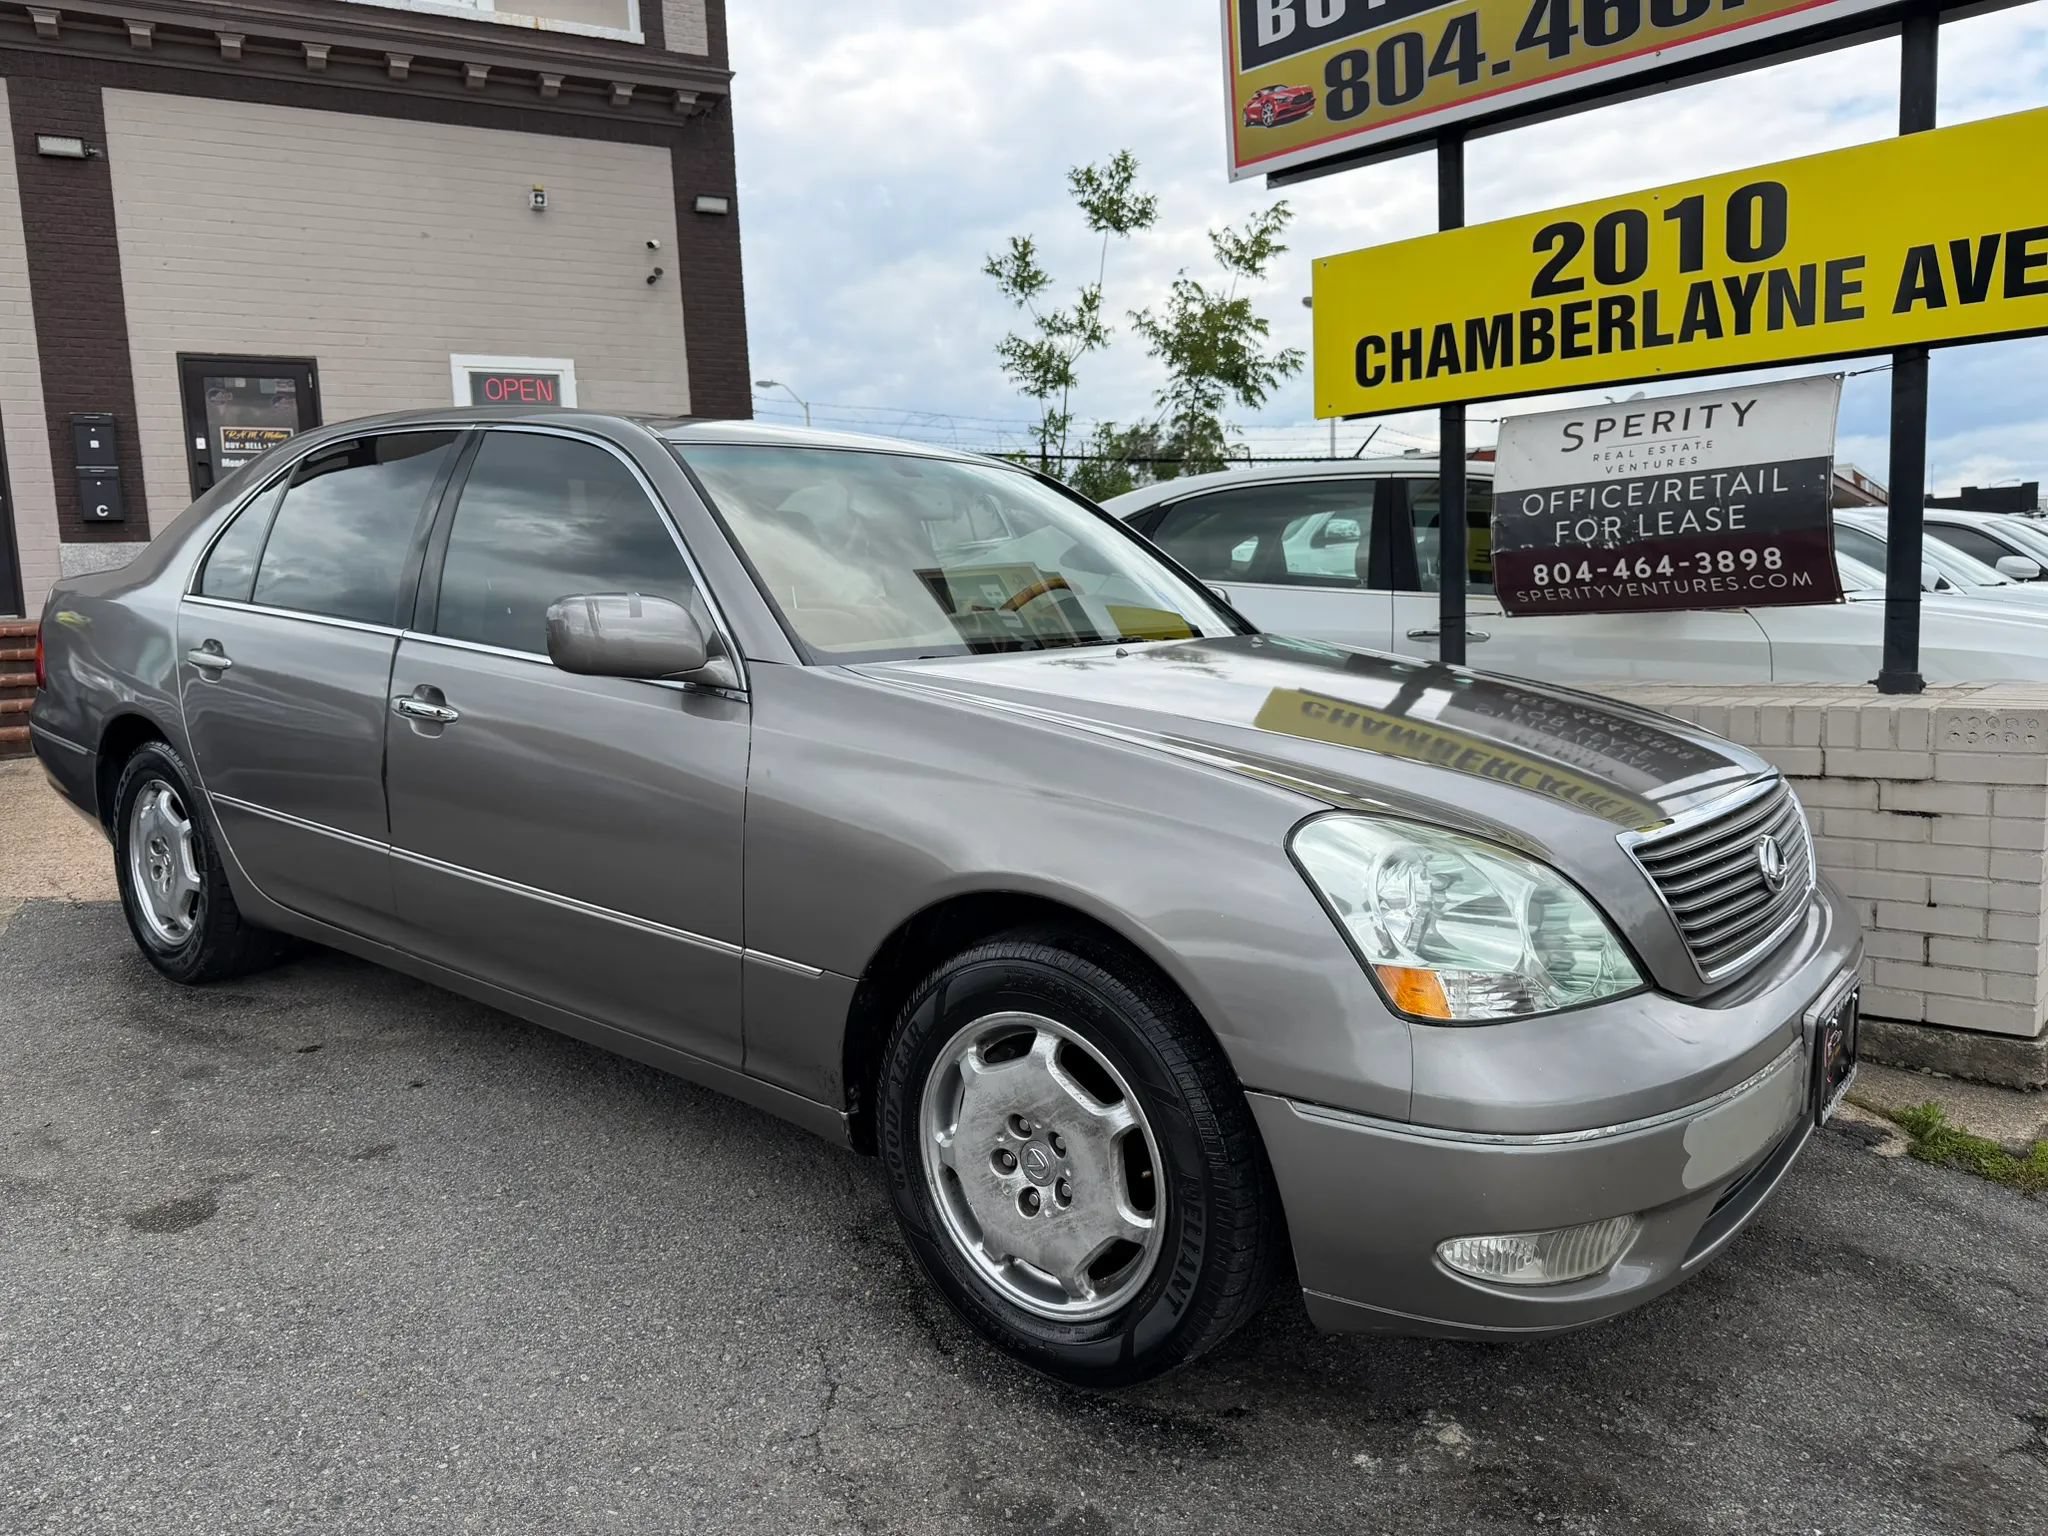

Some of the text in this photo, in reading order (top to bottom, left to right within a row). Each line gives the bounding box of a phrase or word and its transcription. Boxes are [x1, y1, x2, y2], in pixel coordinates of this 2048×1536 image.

[1531, 181, 1787, 298] 2010
[1355, 225, 2048, 388] CHAMBERLAYNE AVE
[485, 377, 553, 402] OPEN
[1561, 399, 1757, 453] SPERITY
[1593, 440, 1714, 463] REAL ESTATE
[1605, 456, 1700, 474] VENTURES
[96, 504, 109, 517] C
[1522, 467, 1788, 517] OFFICE/RETAIL
[1555, 504, 1747, 544] FOR LEASE
[1516, 571, 1813, 603] SPERITYVENTURES.COM
[1533, 547, 1783, 587] 804-464-3898
